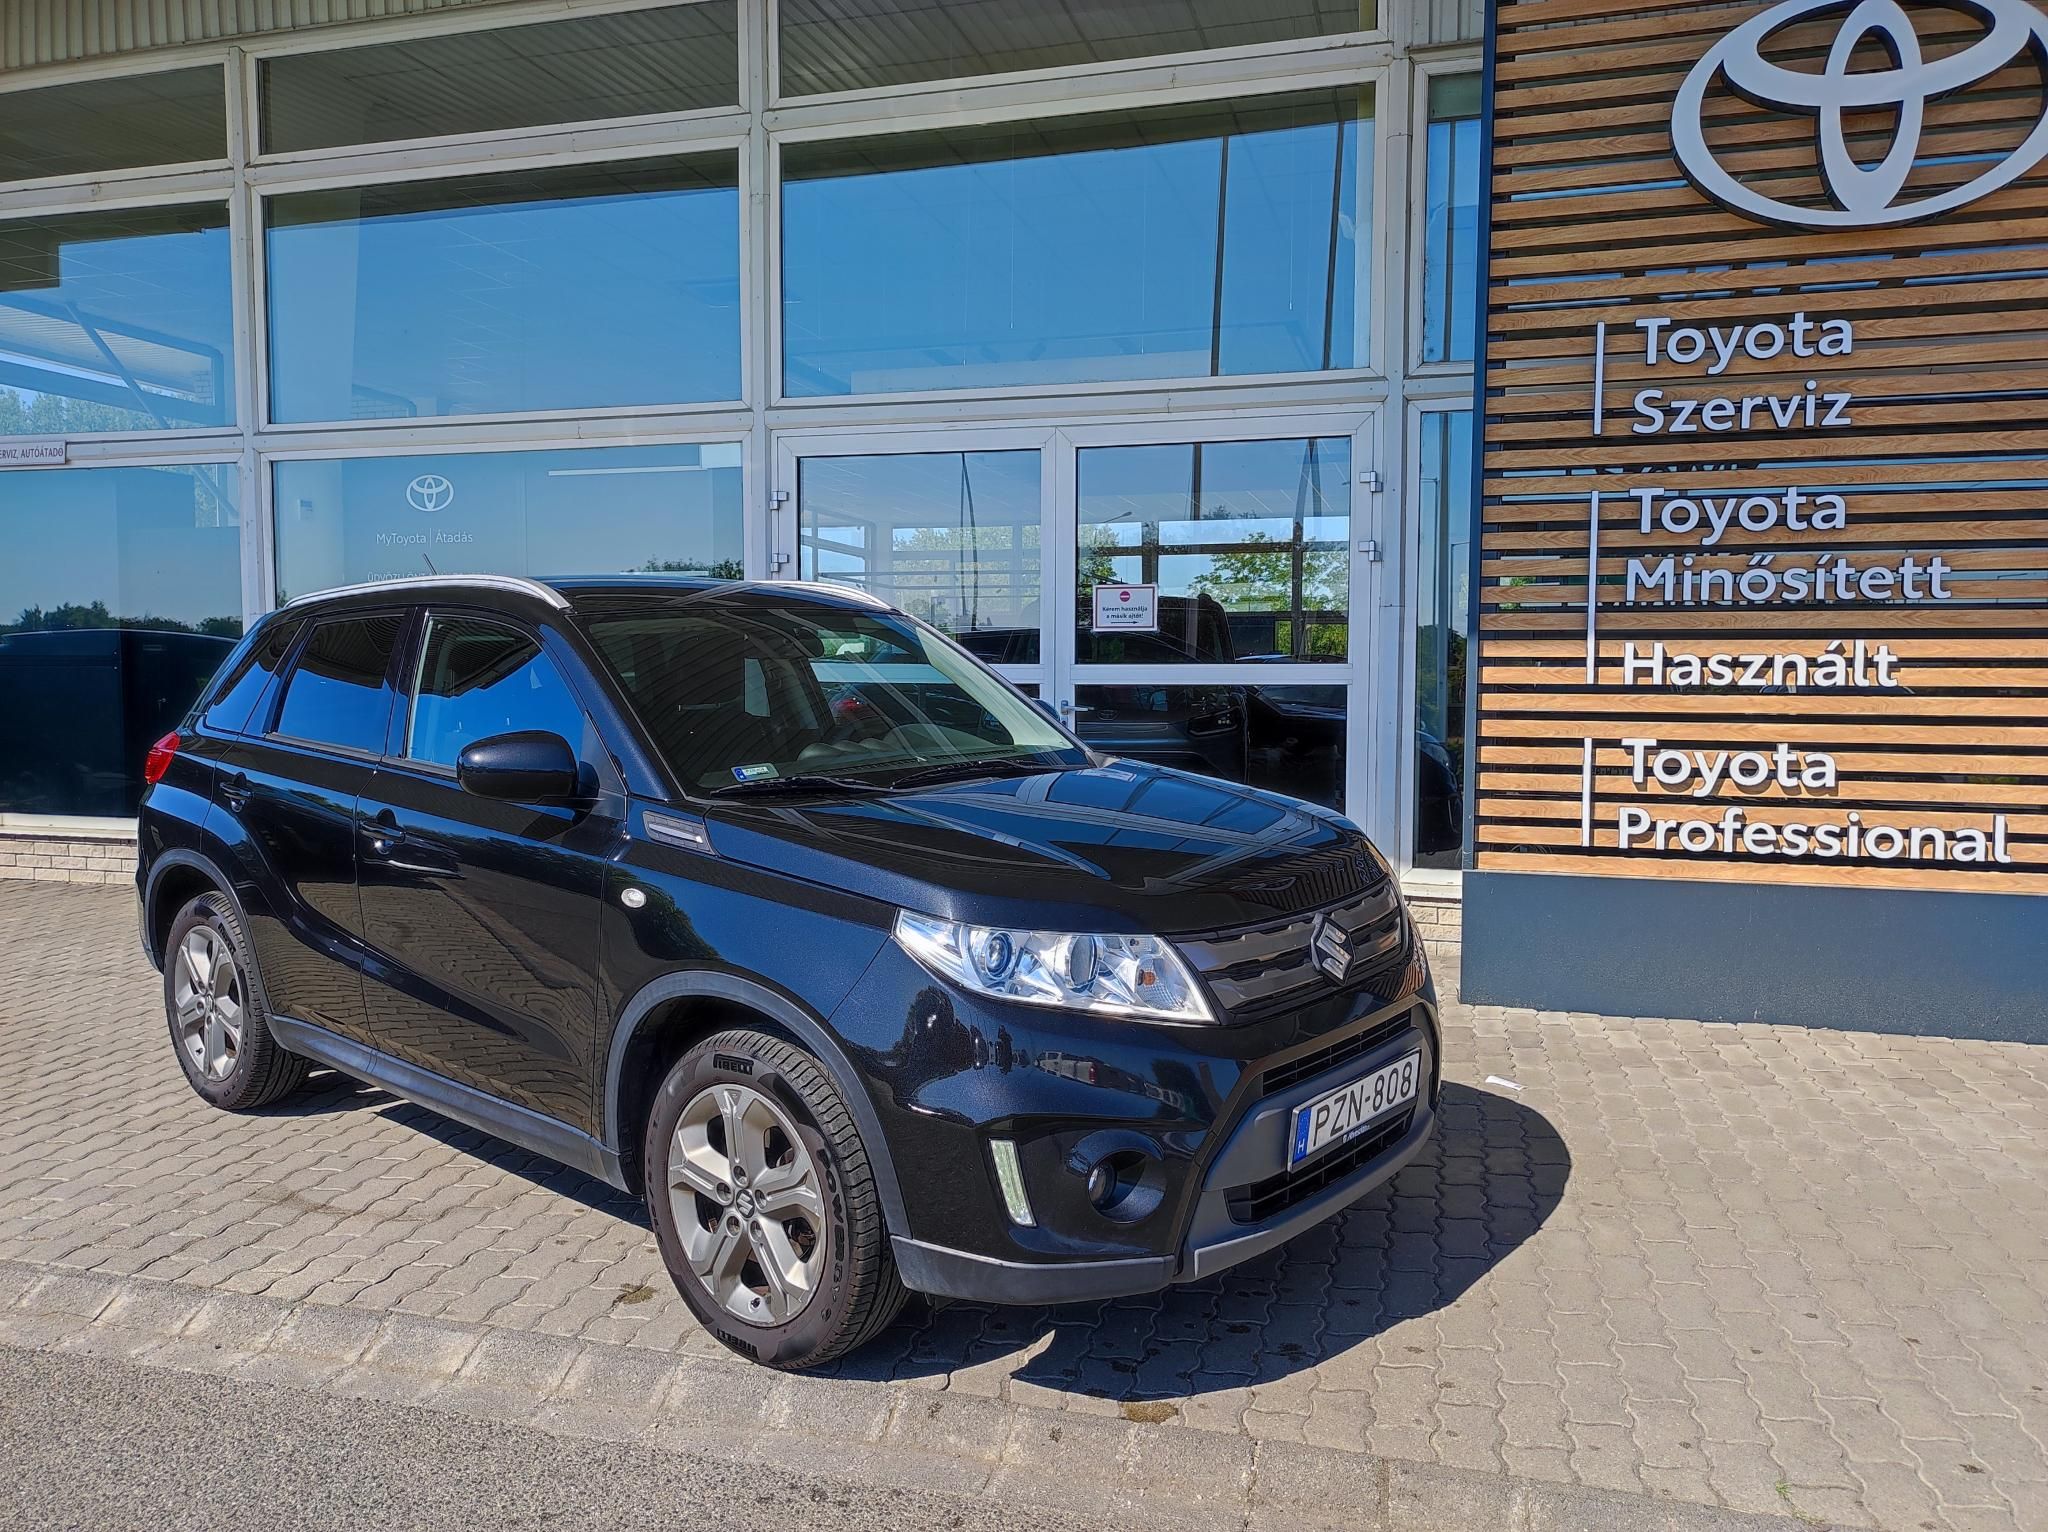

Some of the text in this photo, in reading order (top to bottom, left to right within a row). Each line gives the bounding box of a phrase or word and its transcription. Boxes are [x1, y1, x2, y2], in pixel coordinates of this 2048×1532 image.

[1634, 312, 1854, 375] Toyota
[1632, 380, 1853, 435] Szerviz
[375, 529, 473, 546] MyToyota Átadás
[1628, 486, 1847, 546] Toyota
[1626, 553, 1952, 607] Minősített
[1623, 639, 1899, 689] Használt
[1621, 737, 1837, 798] Toyota
[1618, 807, 2012, 865] Professional
[713, 1054, 754, 1075] PIRELLI
[1313, 1061, 1413, 1147] PZN-808
[1298, 1138, 1305, 1154] H
